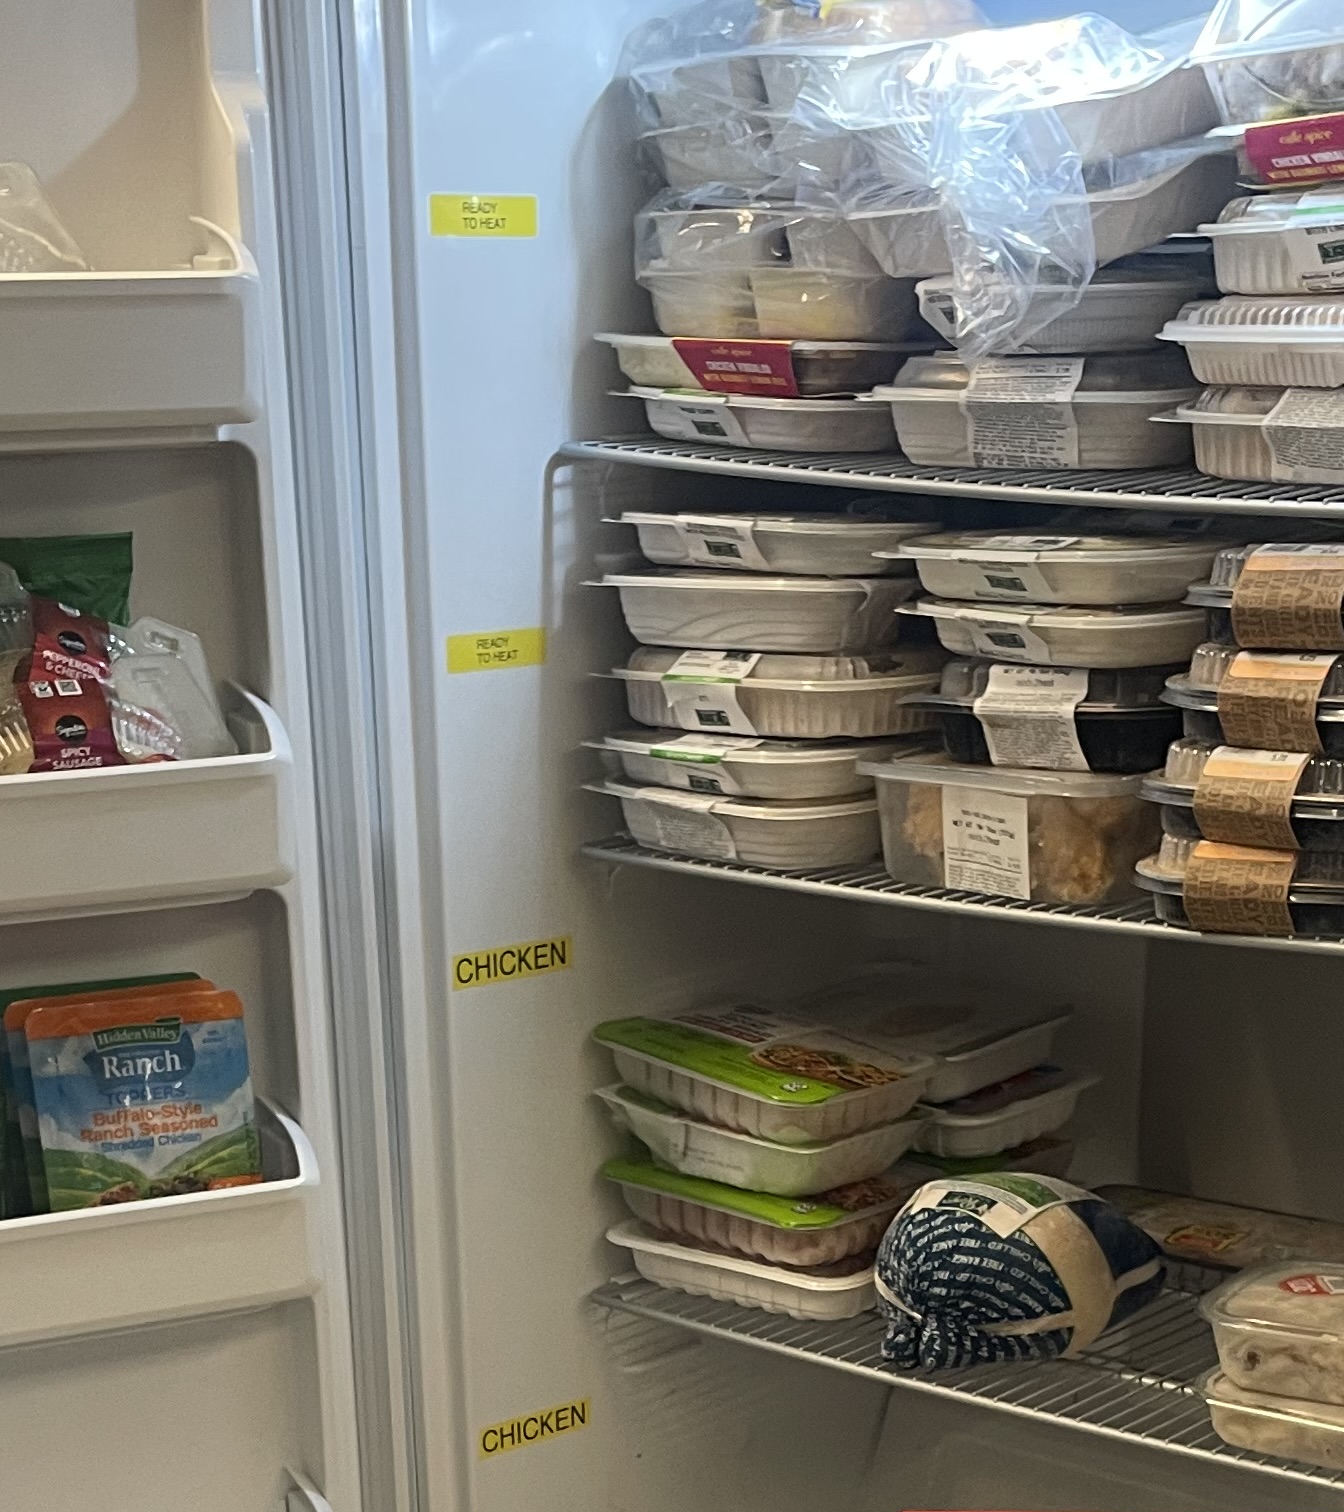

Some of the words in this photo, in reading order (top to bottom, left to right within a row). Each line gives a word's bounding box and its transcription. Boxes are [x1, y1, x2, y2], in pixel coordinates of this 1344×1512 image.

[463, 201, 498, 214] READY
[463, 217, 477, 230] TO
[479, 217, 506, 230] HEAT
[476, 636, 510, 650] READY
[477, 651, 490, 665] TO
[492, 649, 519, 664] HEAT
[60, 746, 92, 759] SPICY
[52, 756, 103, 770] SAUSAGE
[455, 940, 567, 986] CHICKEN
[97, 1028, 142, 1046] Hidden
[142, 1025, 179, 1042] Valley
[102, 1050, 182, 1079] Ranch
[92, 1102, 203, 1128] Buffalo-Style
[80, 1126, 134, 1143] Ranch
[139, 1115, 219, 1137] Seasoned
[481, 1402, 588, 1455] CHICKEN
